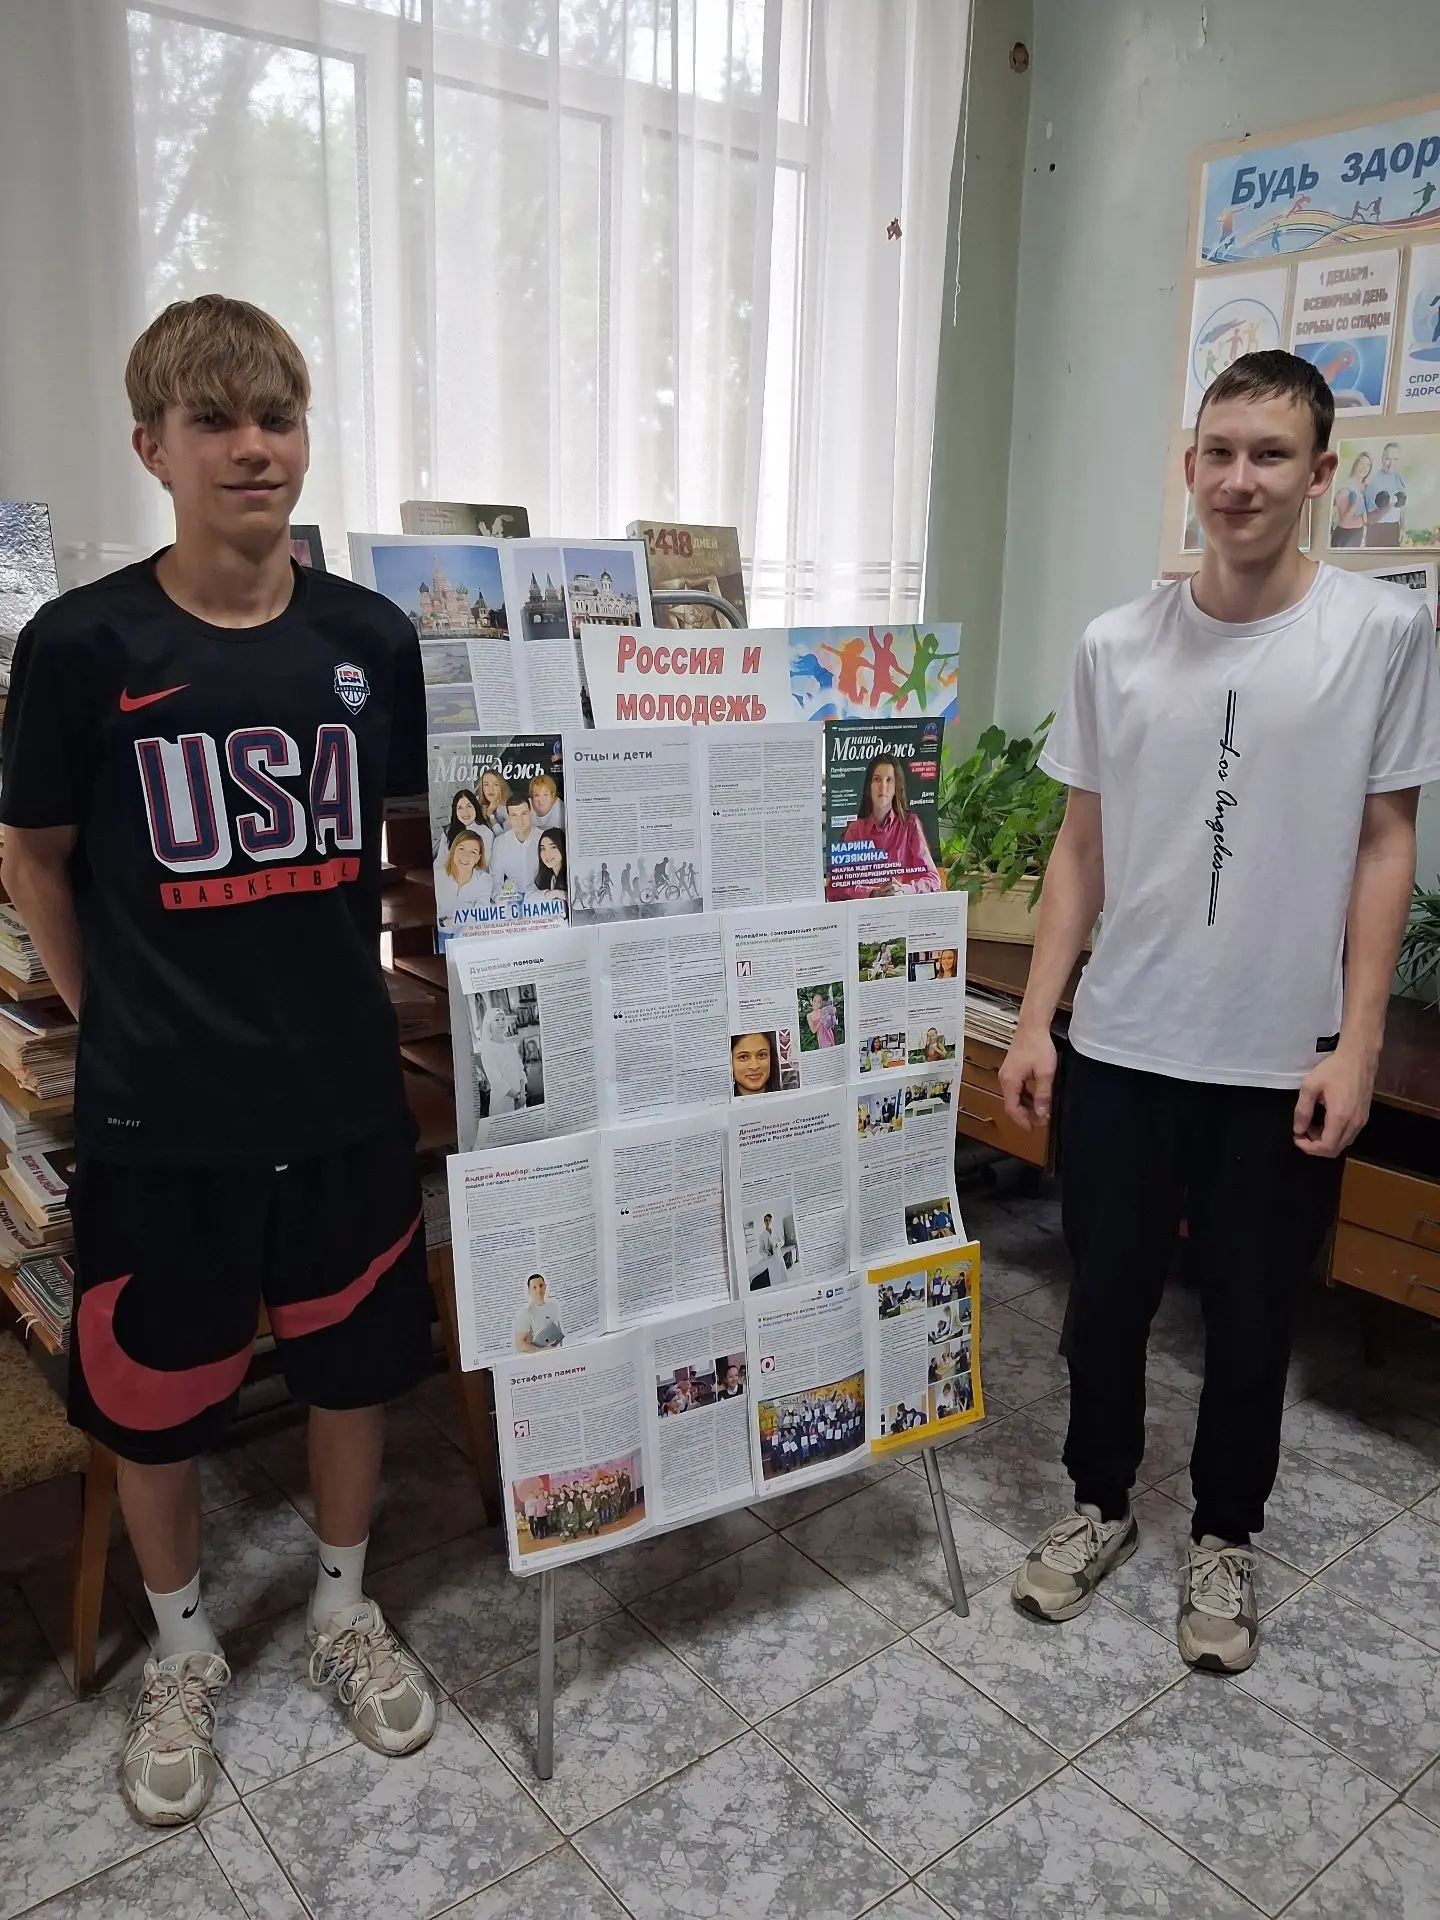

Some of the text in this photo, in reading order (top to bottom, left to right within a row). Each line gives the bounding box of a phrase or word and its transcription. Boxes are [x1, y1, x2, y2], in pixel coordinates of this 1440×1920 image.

[1230, 163, 1320, 210] Будь
[1326, 266, 1369, 287] ДЕКАБРЯ
[1303, 288, 1388, 311] ВСЕМИРНЫЙ ДЕНЬ
[1296, 312, 1391, 336] БОРЬБЫ СО СПИДОМ
[644, 529, 693, 559] 1418
[693, 538, 718, 549] ДНЕЙ
[616, 635, 762, 675] Россия и
[616, 692, 767, 727] молодежь
[851, 736, 877, 744] наша
[459, 754, 494, 764] наша
[574, 751, 653, 762] Отцы и дети
[134, 724, 362, 873] USA
[1204, 789, 1239, 871] Angeles
[831, 840, 875, 853] МАРИНА
[831, 851, 888, 865] КУЗЯКИНА:
[454, 900, 564, 924] ЛУЧШИЕ С НАМИ!
[469, 962, 512, 975] Душевная
[513, 957, 545, 967] помощь
[107, 1117, 142, 1128] DRI-FIT
[464, 1173, 494, 1183] Андрей
[510, 1366, 586, 1386] Эстафета памяти
